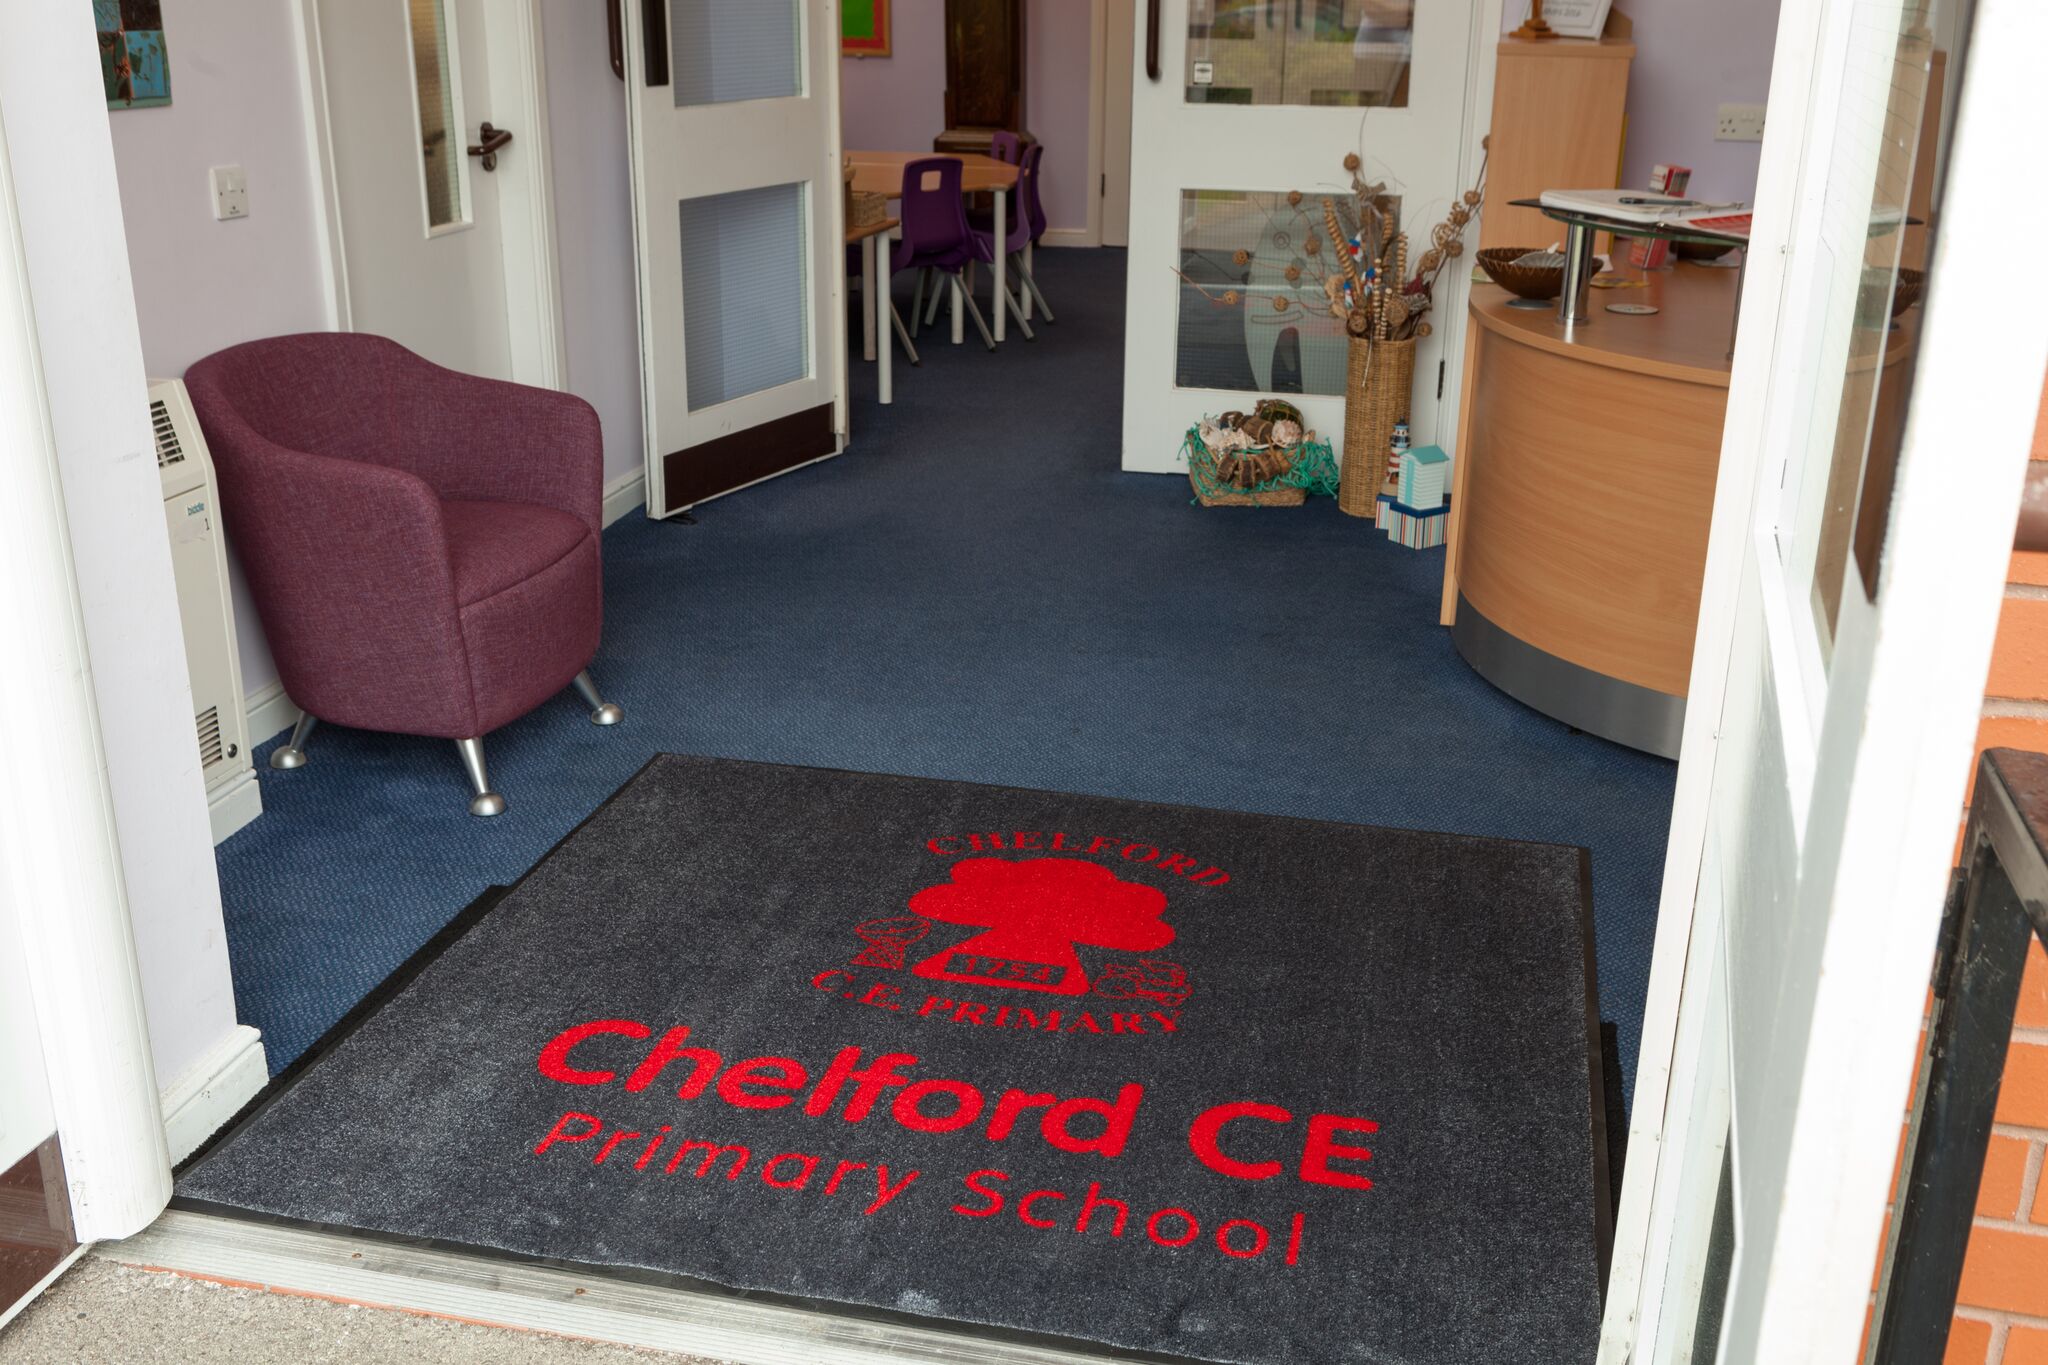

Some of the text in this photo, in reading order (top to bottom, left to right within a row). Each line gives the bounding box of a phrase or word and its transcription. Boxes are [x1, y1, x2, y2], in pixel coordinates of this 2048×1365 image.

[927, 831, 1231, 887] CHELFORD
[965, 957, 1051, 981] 1754
[915, 995, 1182, 1035] PRIMARY
[537, 1018, 1380, 1191] Chelford CE
[533, 1110, 1306, 1266] Primary School
